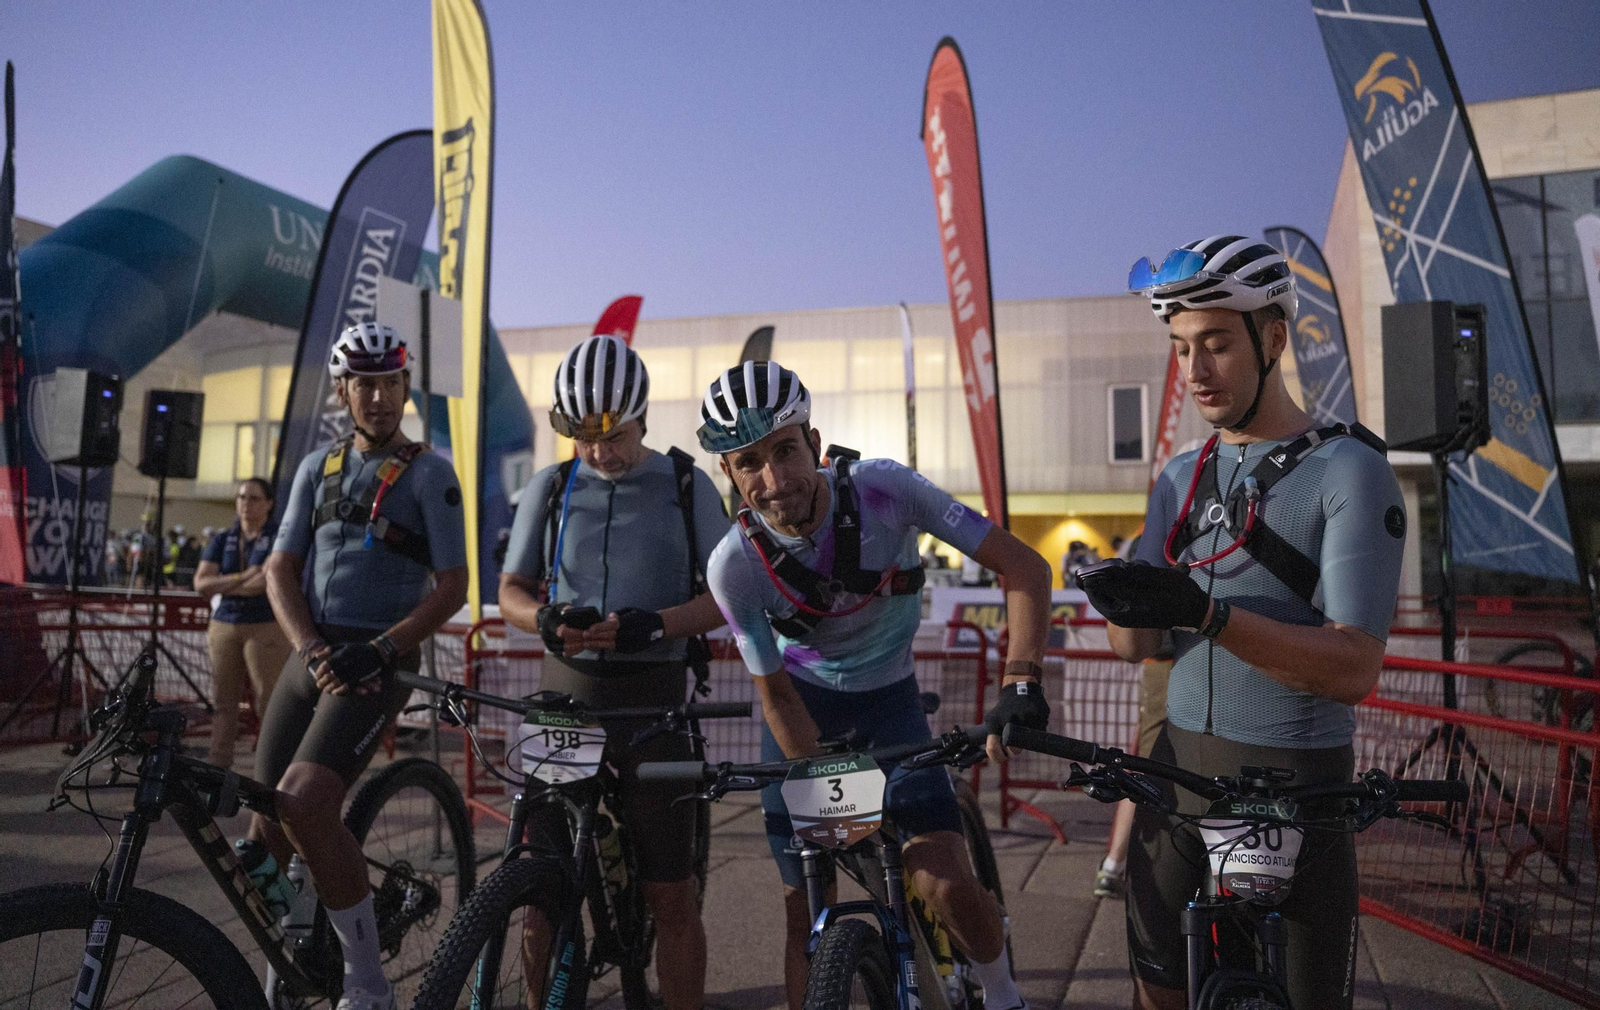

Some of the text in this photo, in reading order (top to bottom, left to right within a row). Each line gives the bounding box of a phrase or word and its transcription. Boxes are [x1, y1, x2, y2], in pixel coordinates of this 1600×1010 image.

[541, 728, 580, 749] 198
[827, 777, 844, 803] 3
[819, 804, 857, 816] HAIMAR
